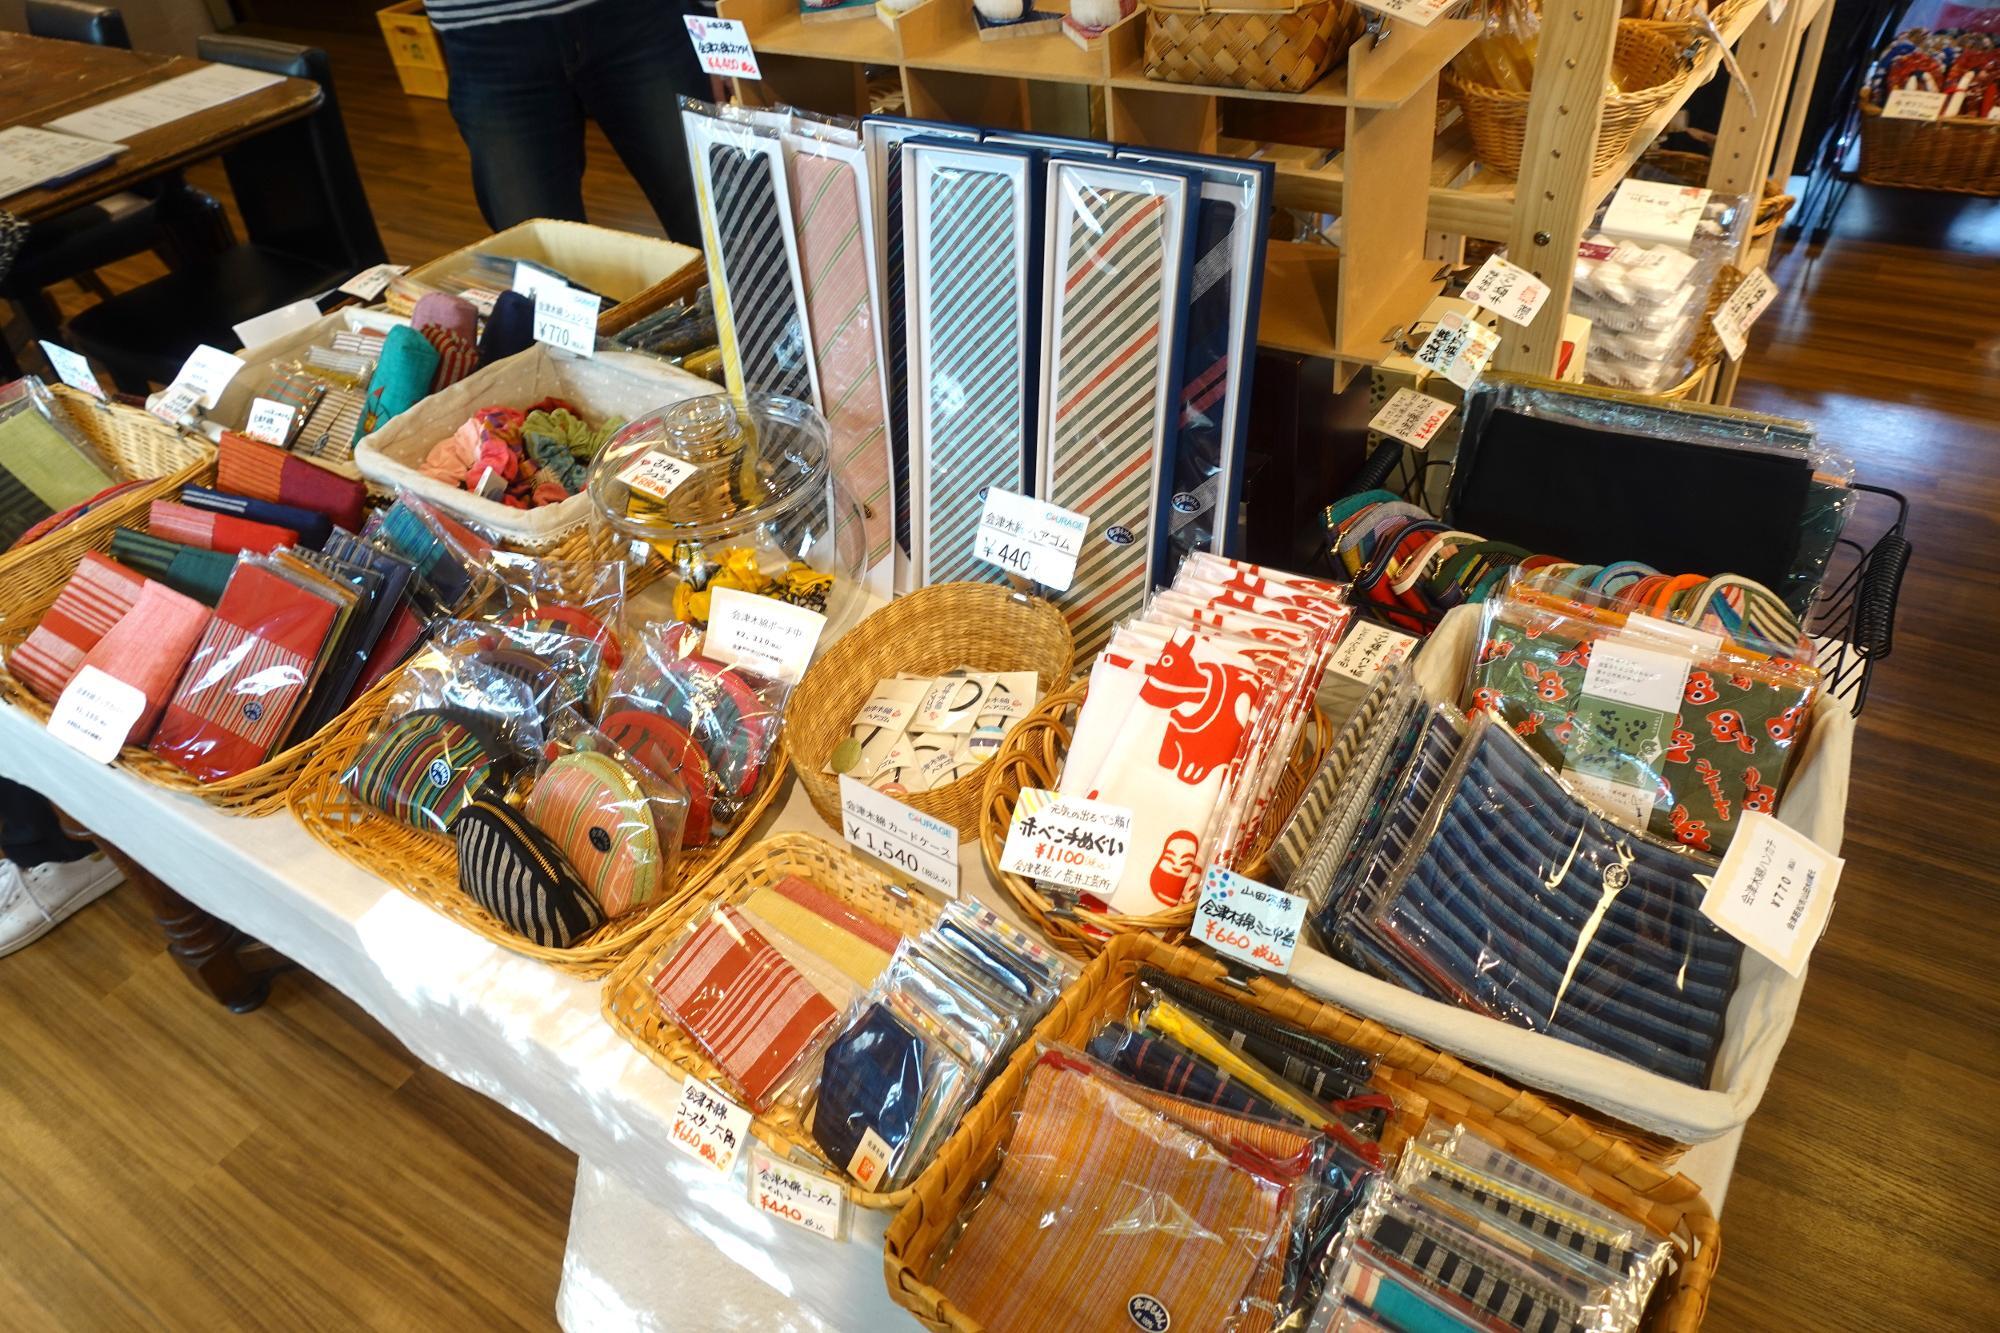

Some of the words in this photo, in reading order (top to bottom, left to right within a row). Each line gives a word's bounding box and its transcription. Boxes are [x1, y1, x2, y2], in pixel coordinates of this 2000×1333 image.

[983, 537, 1031, 571] ¥440
[847, 821, 918, 872] ¥1,540
[1019, 816, 1124, 856] 赤べこ手ぬぐい
[1770, 875, 1793, 909] ¥770
[1205, 919, 1251, 949] ¥660
[760, 1193, 802, 1221] ¥440
